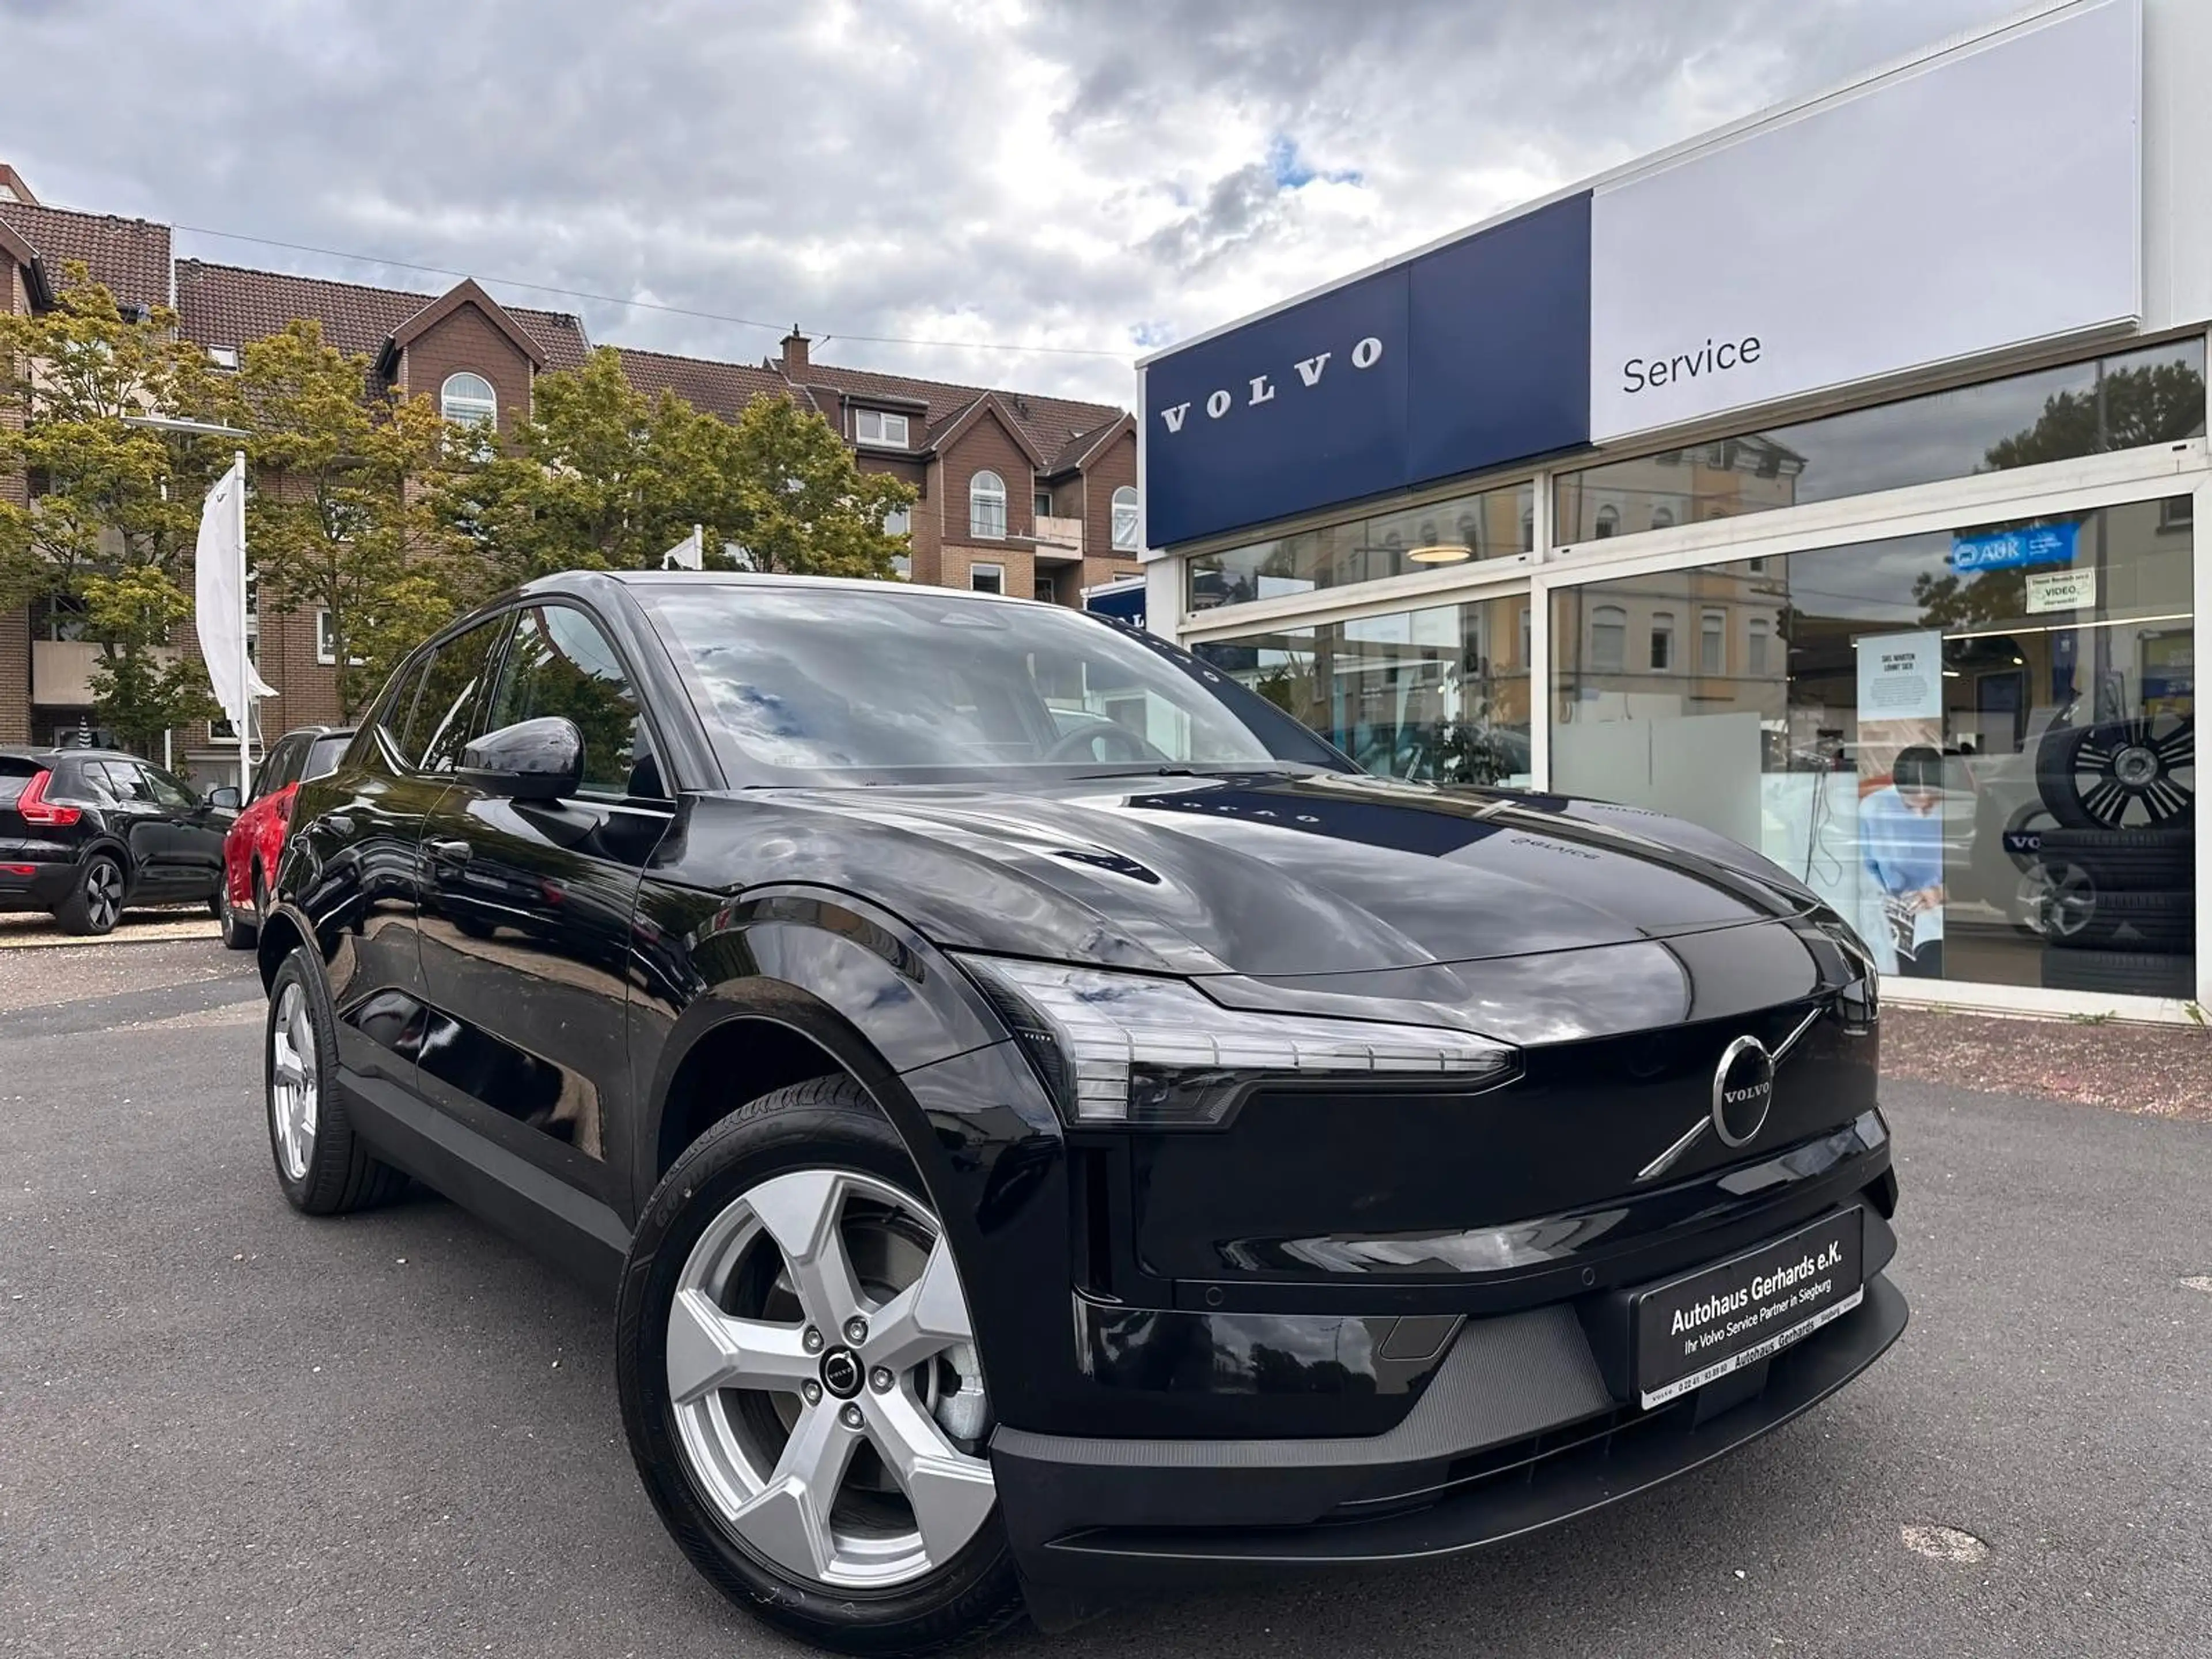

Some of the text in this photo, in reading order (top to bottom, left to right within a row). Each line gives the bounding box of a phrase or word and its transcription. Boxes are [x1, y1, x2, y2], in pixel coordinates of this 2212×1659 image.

[1161, 336, 1382, 433] VOLVO
[1622, 336, 1762, 394] Service
[2045, 585, 2076, 597] VIDEO
[1724, 1081, 1770, 1104] VOLVO
[1671, 1240, 1842, 1336] Autohaus Gerhards e.K.
[1684, 1339, 1698, 1355] Ihr
[1699, 1329, 1725, 1349] Volvo
[1726, 1313, 1758, 1337] Service
[1759, 1300, 1789, 1323] Partner
[1790, 1296, 1798, 1308] in
[1798, 1278, 1832, 1304] Siegburg
[1734, 1342, 1775, 1369] Autohaus
[1778, 1320, 1815, 1346] Gerhards
